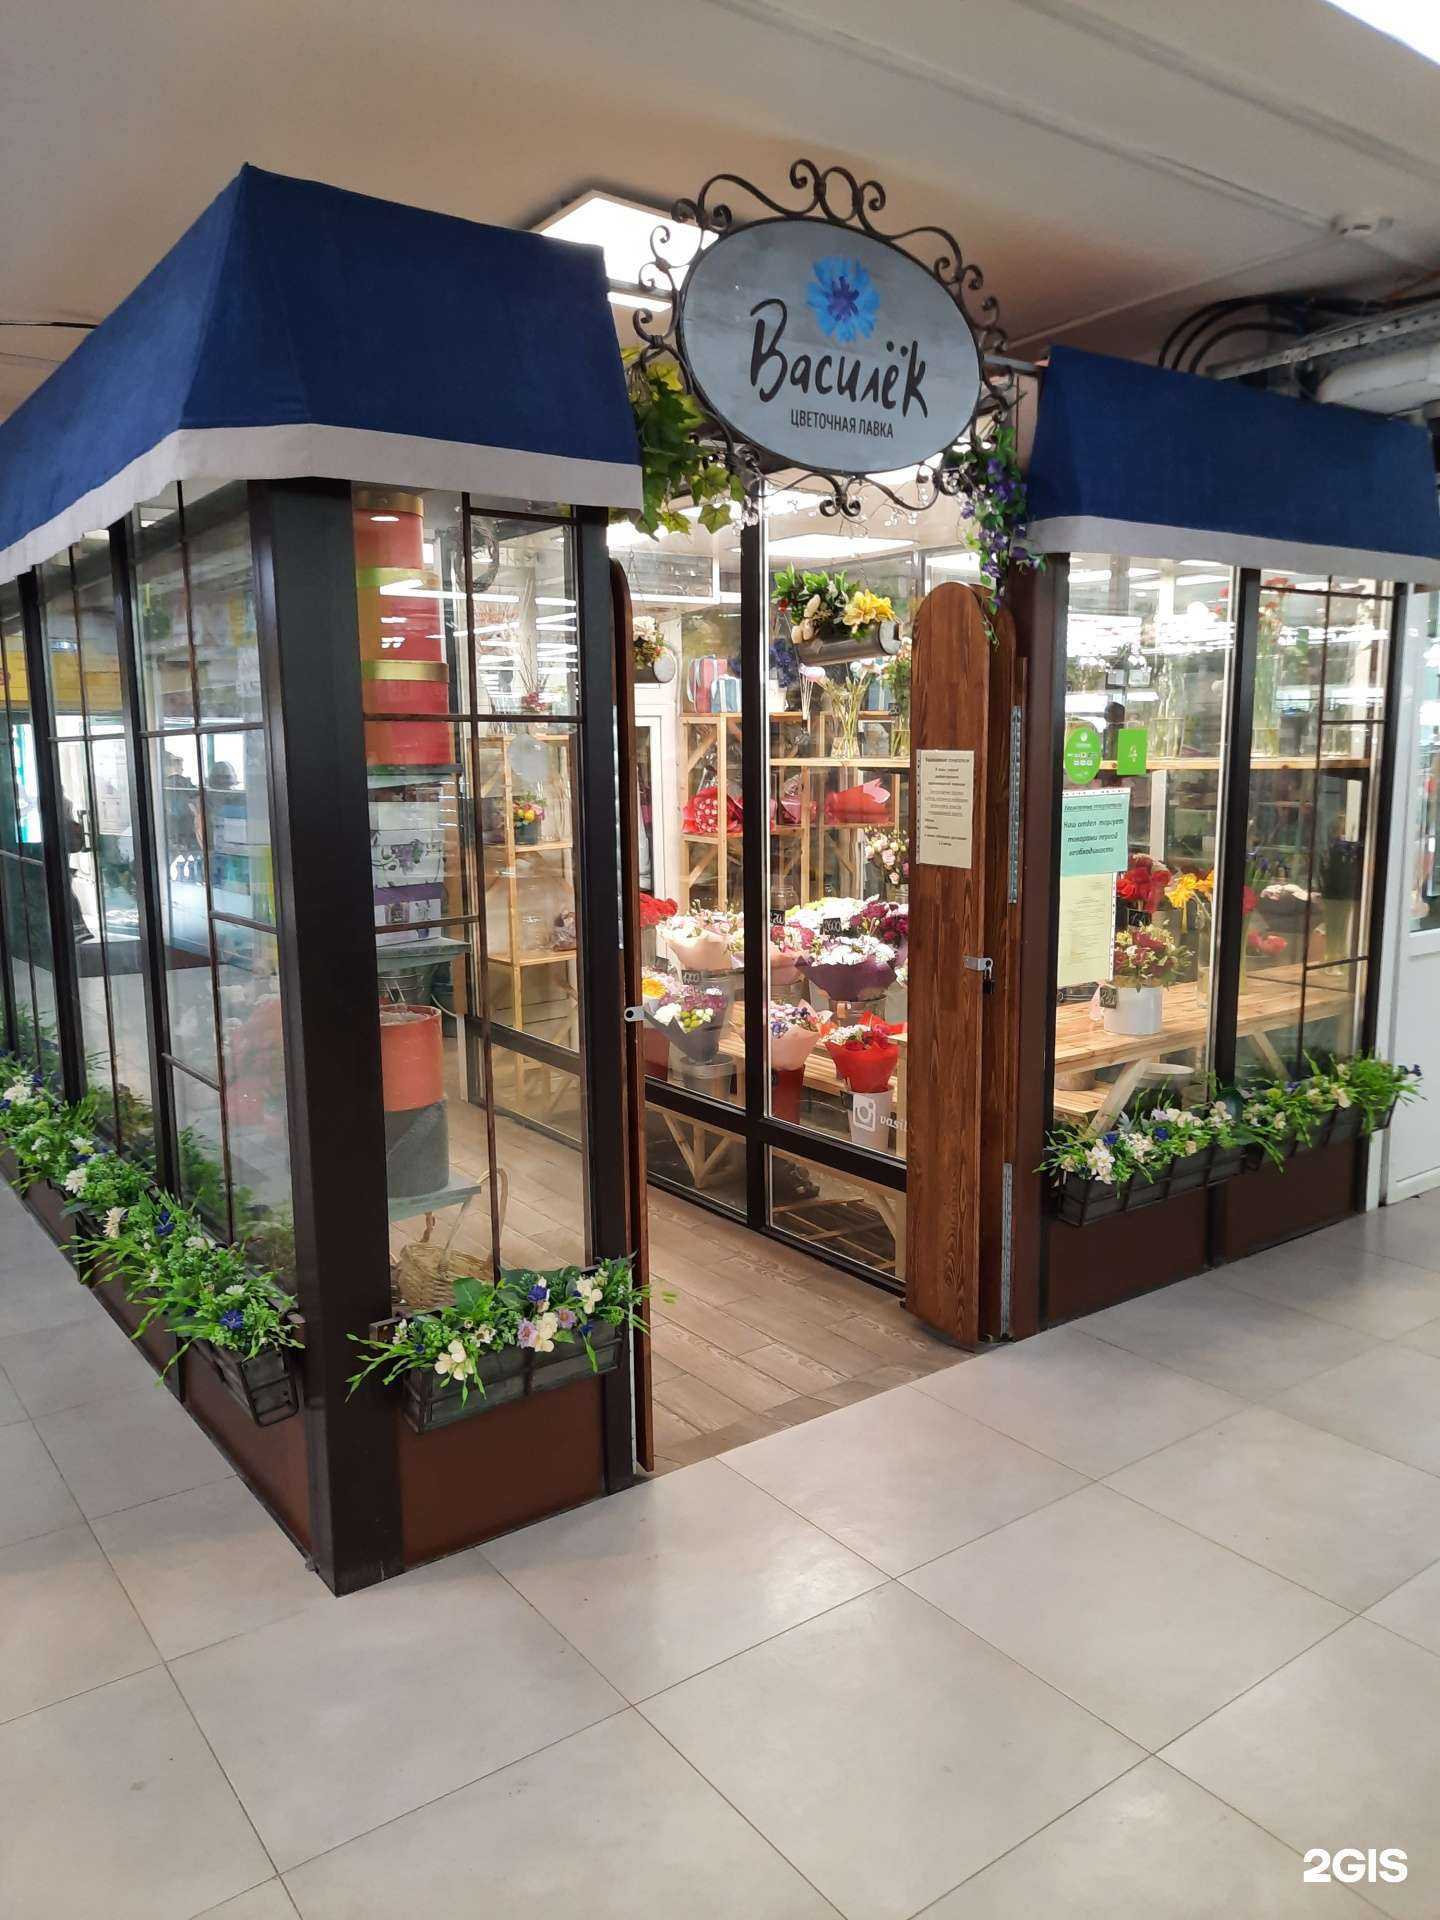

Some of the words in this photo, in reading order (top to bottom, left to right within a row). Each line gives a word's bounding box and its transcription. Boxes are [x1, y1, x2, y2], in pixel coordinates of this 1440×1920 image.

[750, 298, 928, 418] Василёк
[790, 408, 856, 433] ЦВЕТОЧНАЯ
[858, 417, 894, 439] ЛАВКА
